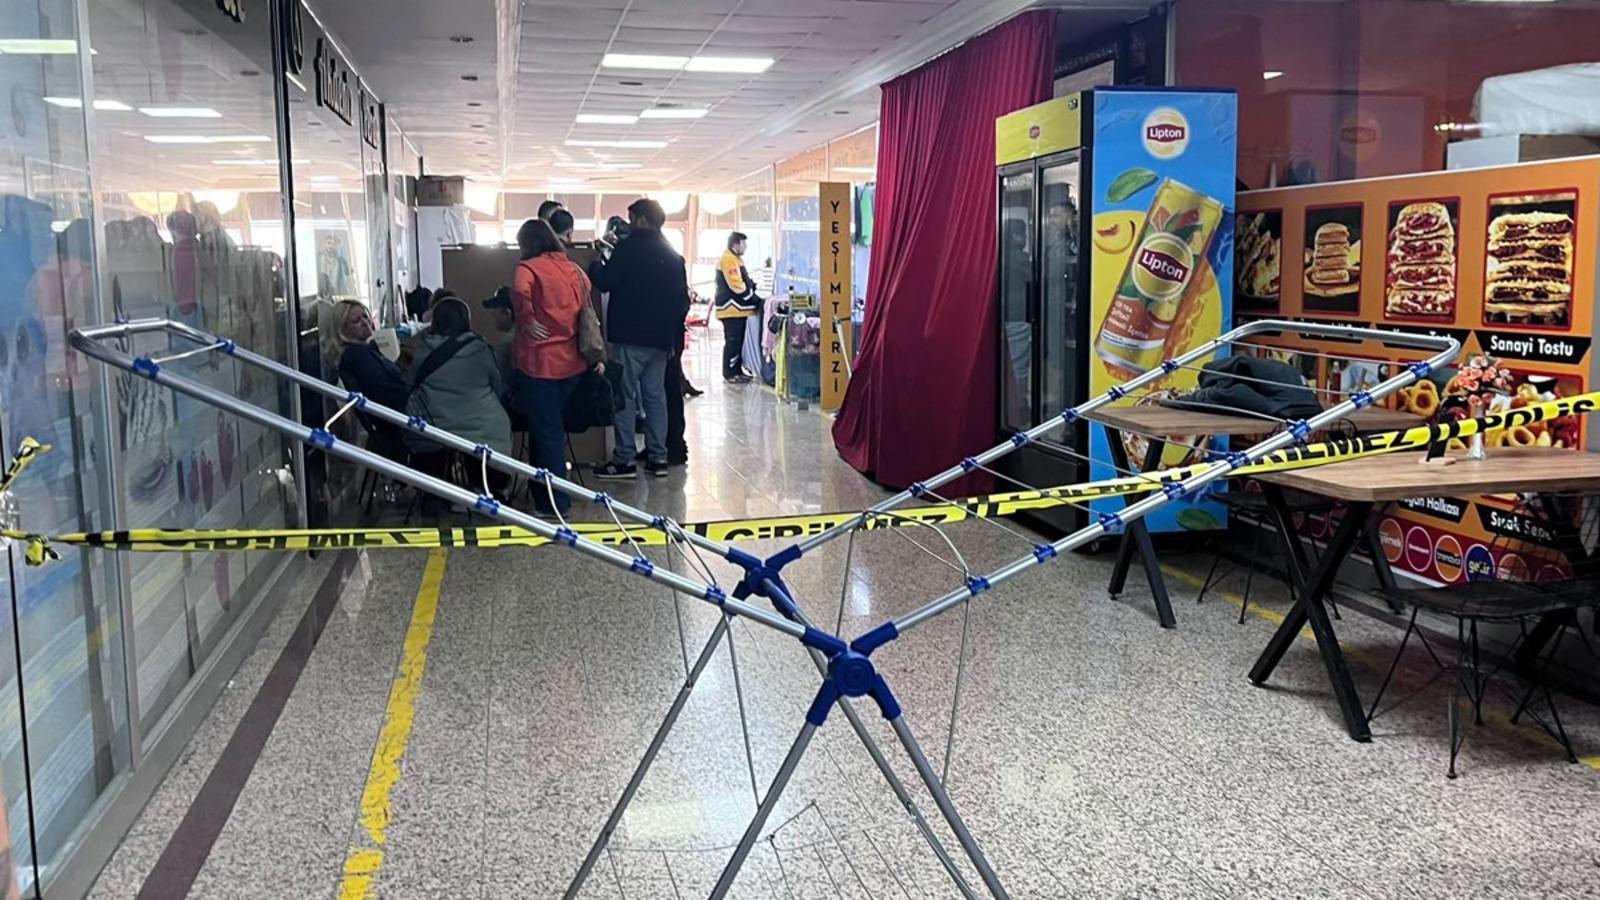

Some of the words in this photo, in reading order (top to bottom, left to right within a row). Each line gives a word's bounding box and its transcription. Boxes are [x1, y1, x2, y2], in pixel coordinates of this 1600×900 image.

[1150, 127, 1182, 139] Lipton
[1142, 252, 1183, 280] Lipton
[1491, 335, 1533, 356] Sanayi
[1538, 338, 1573, 356] Tostu
